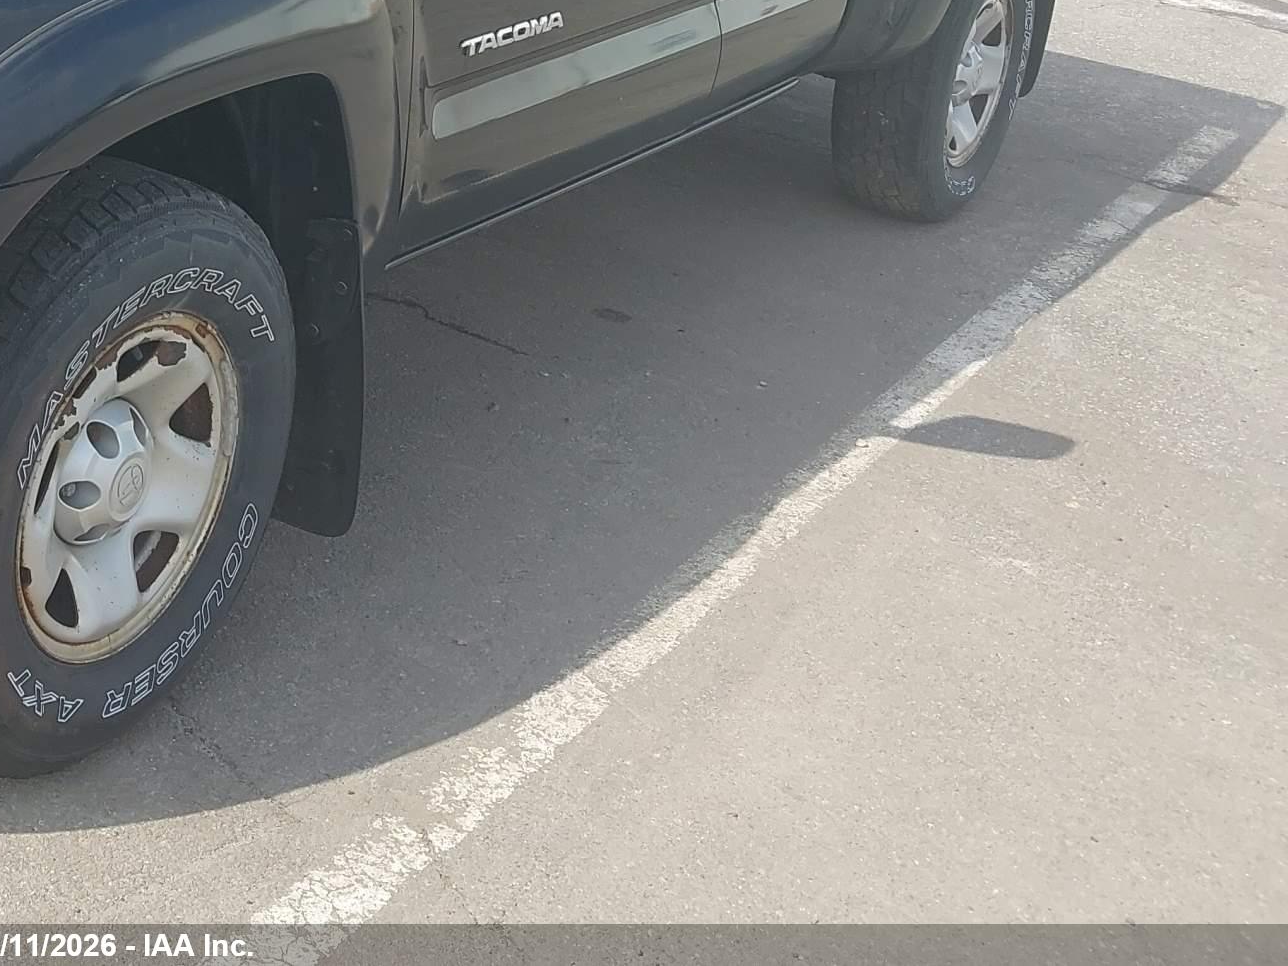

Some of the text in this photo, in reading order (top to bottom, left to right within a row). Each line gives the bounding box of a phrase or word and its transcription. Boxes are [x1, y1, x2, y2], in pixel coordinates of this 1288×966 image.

[460, 11, 564, 56] TACOMA
[17, 267, 275, 490] MASTERCRAFT
[7, 502, 259, 723] COURSER AXT
